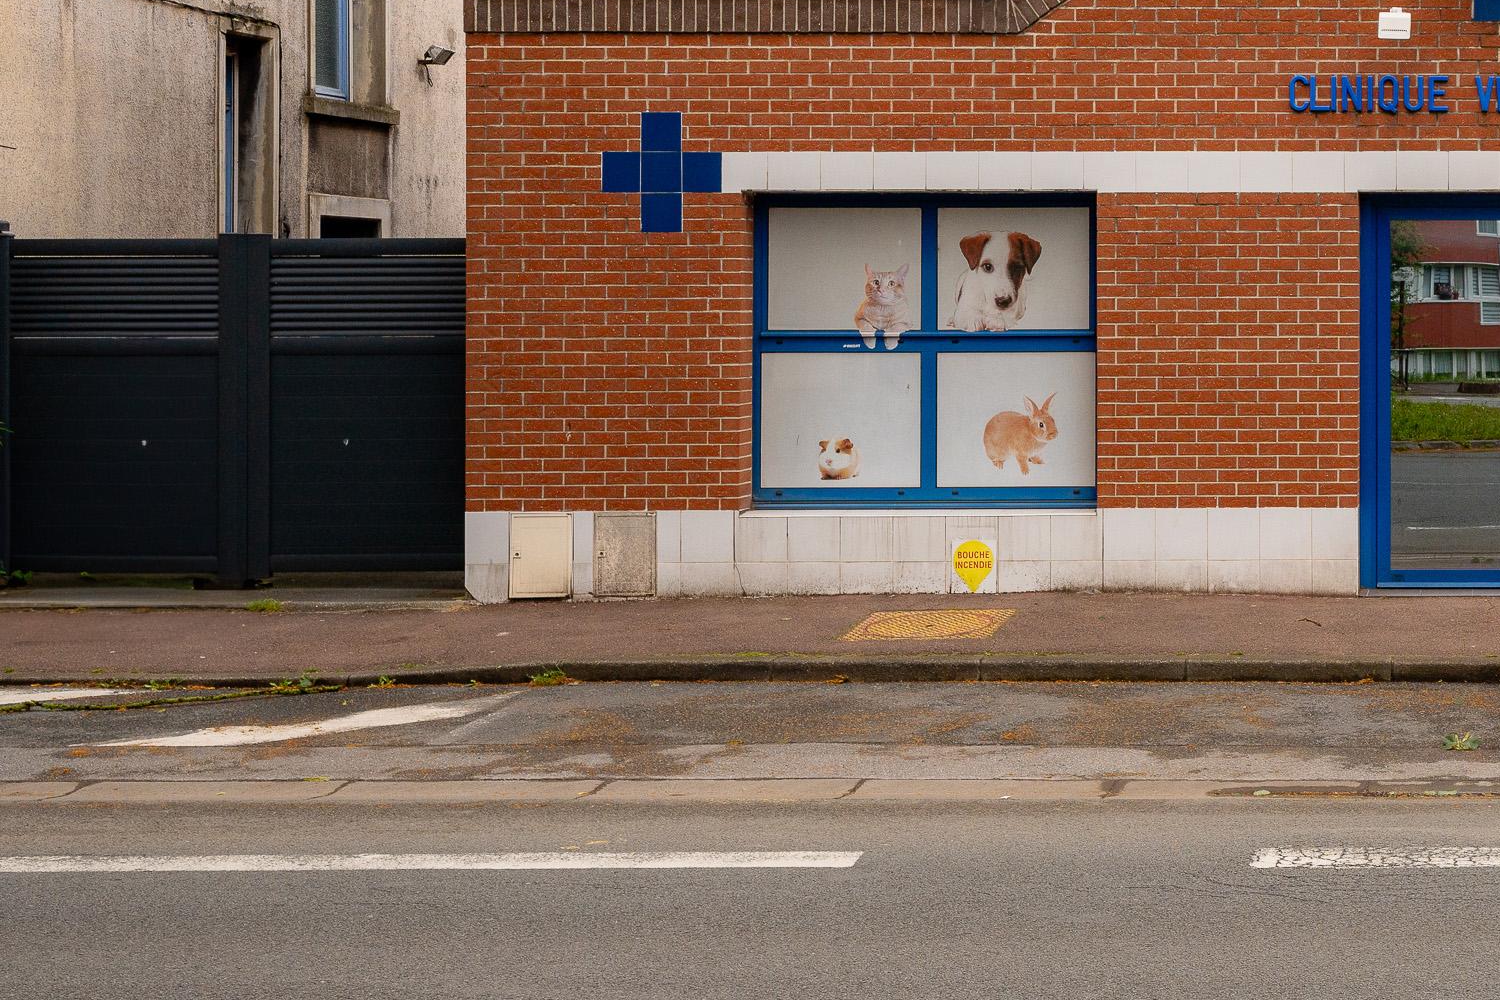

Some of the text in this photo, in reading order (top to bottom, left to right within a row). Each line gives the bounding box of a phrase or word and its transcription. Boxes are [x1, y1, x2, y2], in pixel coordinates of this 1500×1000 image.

[1288, 74, 1449, 113] CLINIQUE
[957, 550, 990, 559] BOUCHE
[955, 560, 992, 569] INCENDIE
